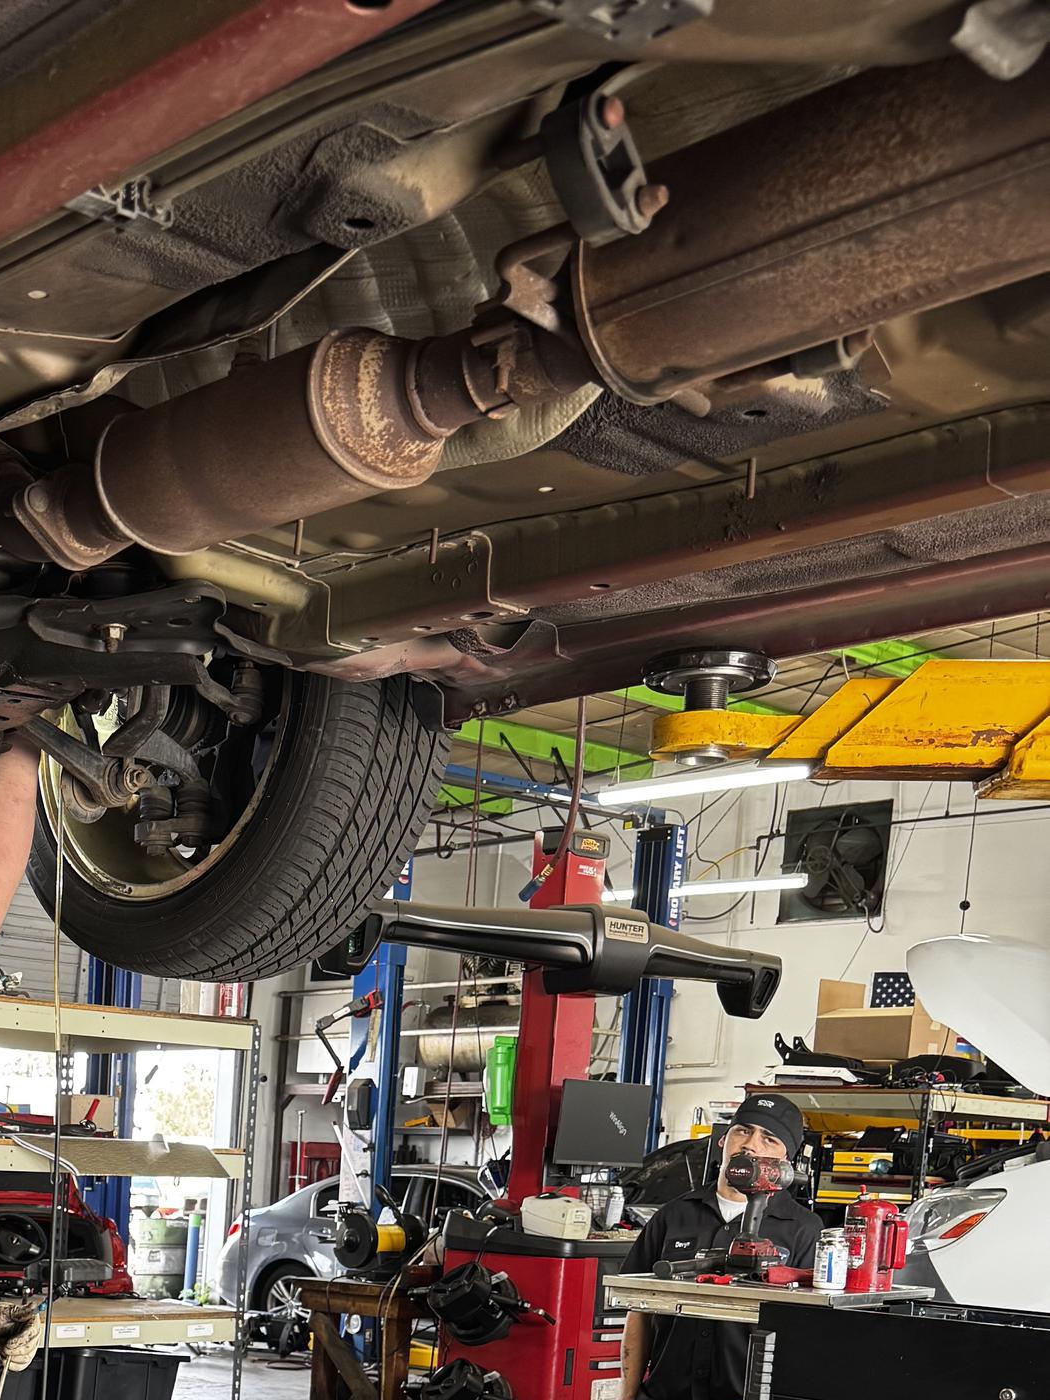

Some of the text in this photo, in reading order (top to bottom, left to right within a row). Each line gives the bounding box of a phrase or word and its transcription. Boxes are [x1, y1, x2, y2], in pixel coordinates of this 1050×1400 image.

[670, 826, 686, 919] ROARY LIFT
[610, 921, 645, 934] HUNTER
